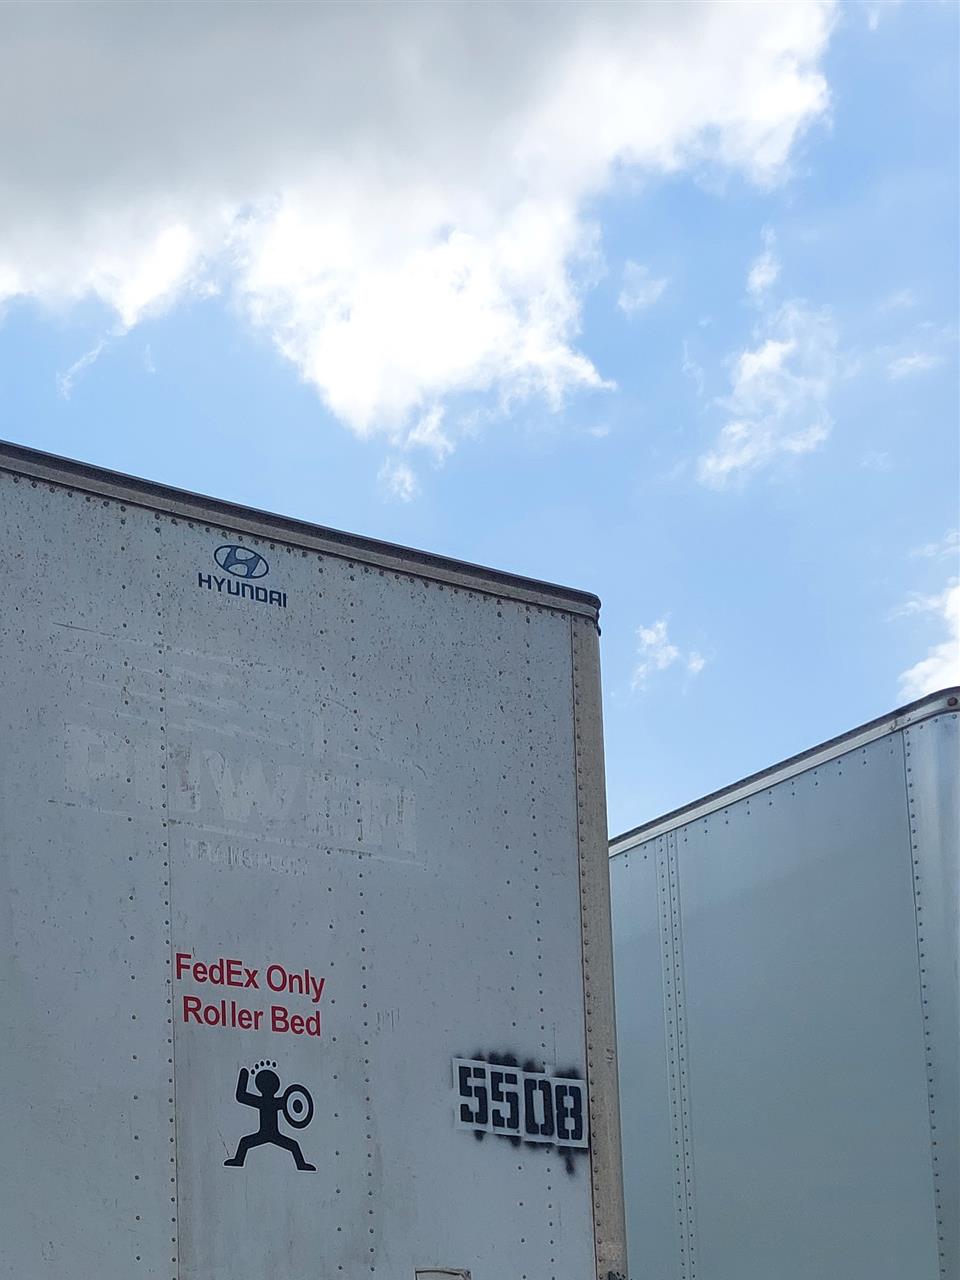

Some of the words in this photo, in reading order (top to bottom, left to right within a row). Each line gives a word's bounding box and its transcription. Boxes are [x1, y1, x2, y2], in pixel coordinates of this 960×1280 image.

[198, 572, 287, 608] HYUNDAI
[175, 952, 260, 989] FedEx
[266, 964, 326, 1003] Only
[182, 995, 264, 1030] Roller
[270, 1005, 321, 1037] Bed
[458, 1065, 583, 1141] 5508
